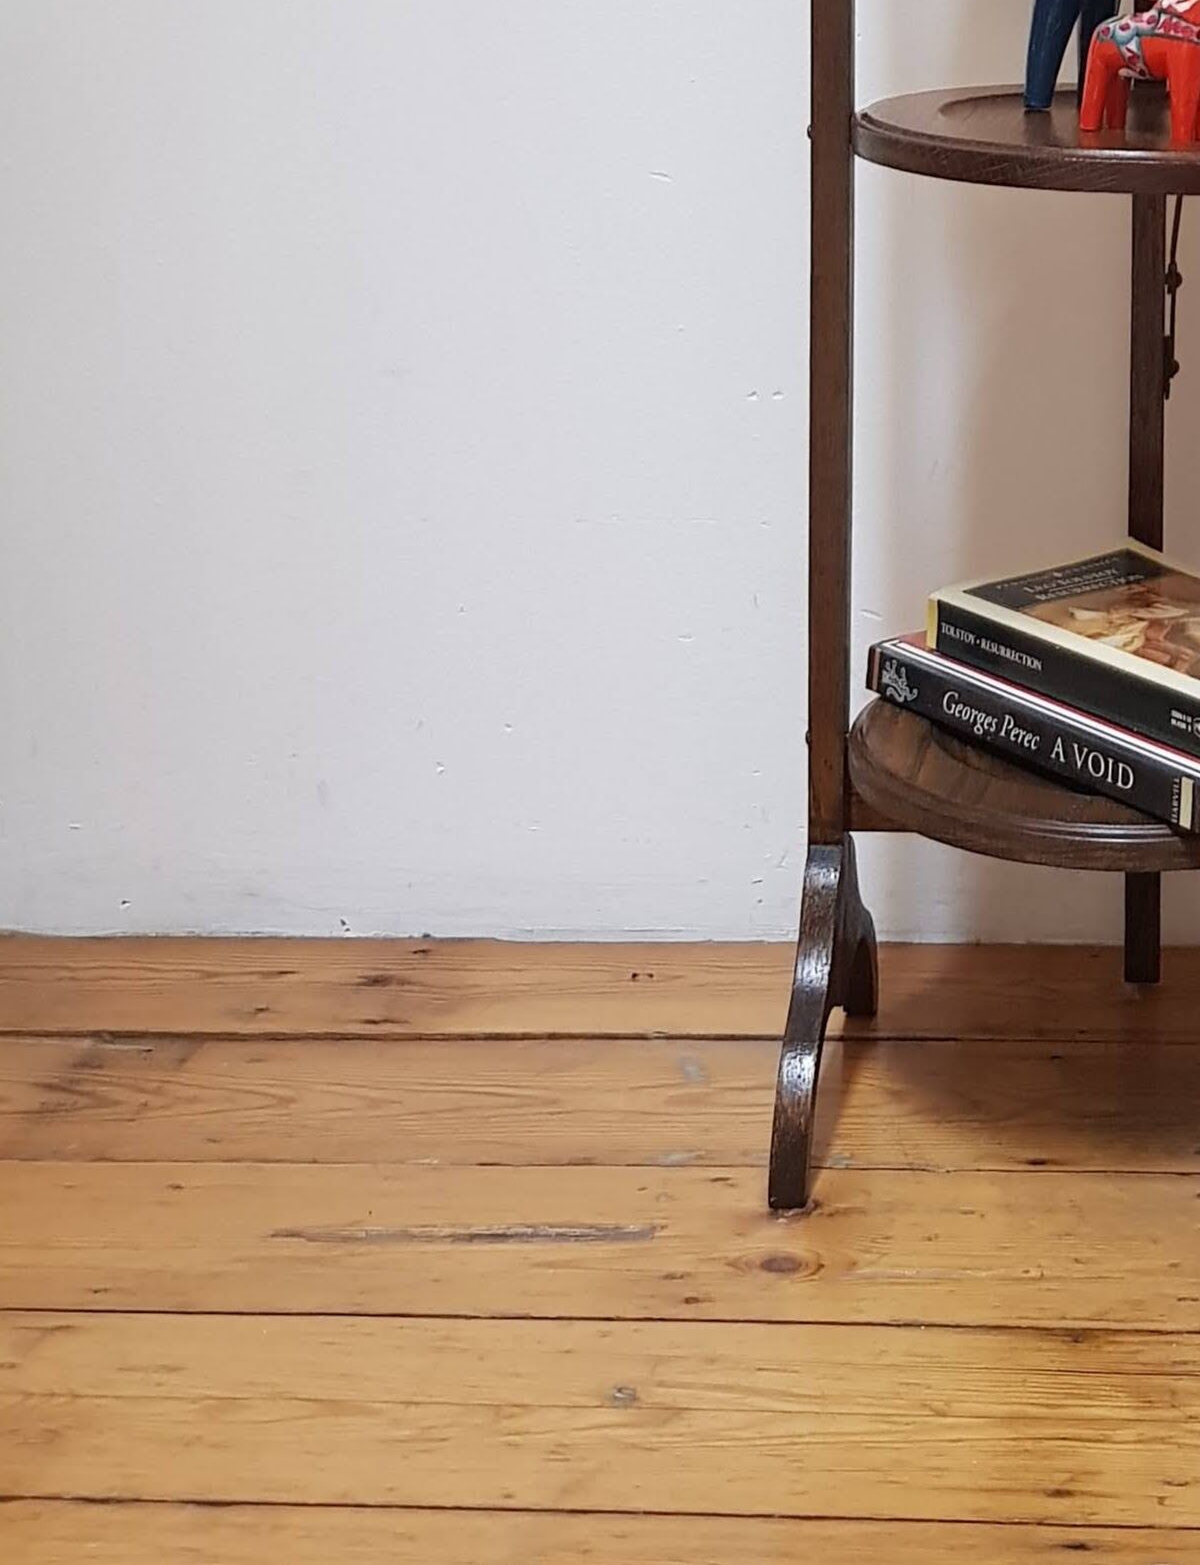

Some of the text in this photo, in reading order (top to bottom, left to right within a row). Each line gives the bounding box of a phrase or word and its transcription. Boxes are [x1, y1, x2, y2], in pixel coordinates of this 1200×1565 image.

[941, 622, 1043, 672] TOLSTOY RESURRECTION
[942, 690, 1041, 751] Georges Perec
[1050, 736, 1135, 790] A VOID
